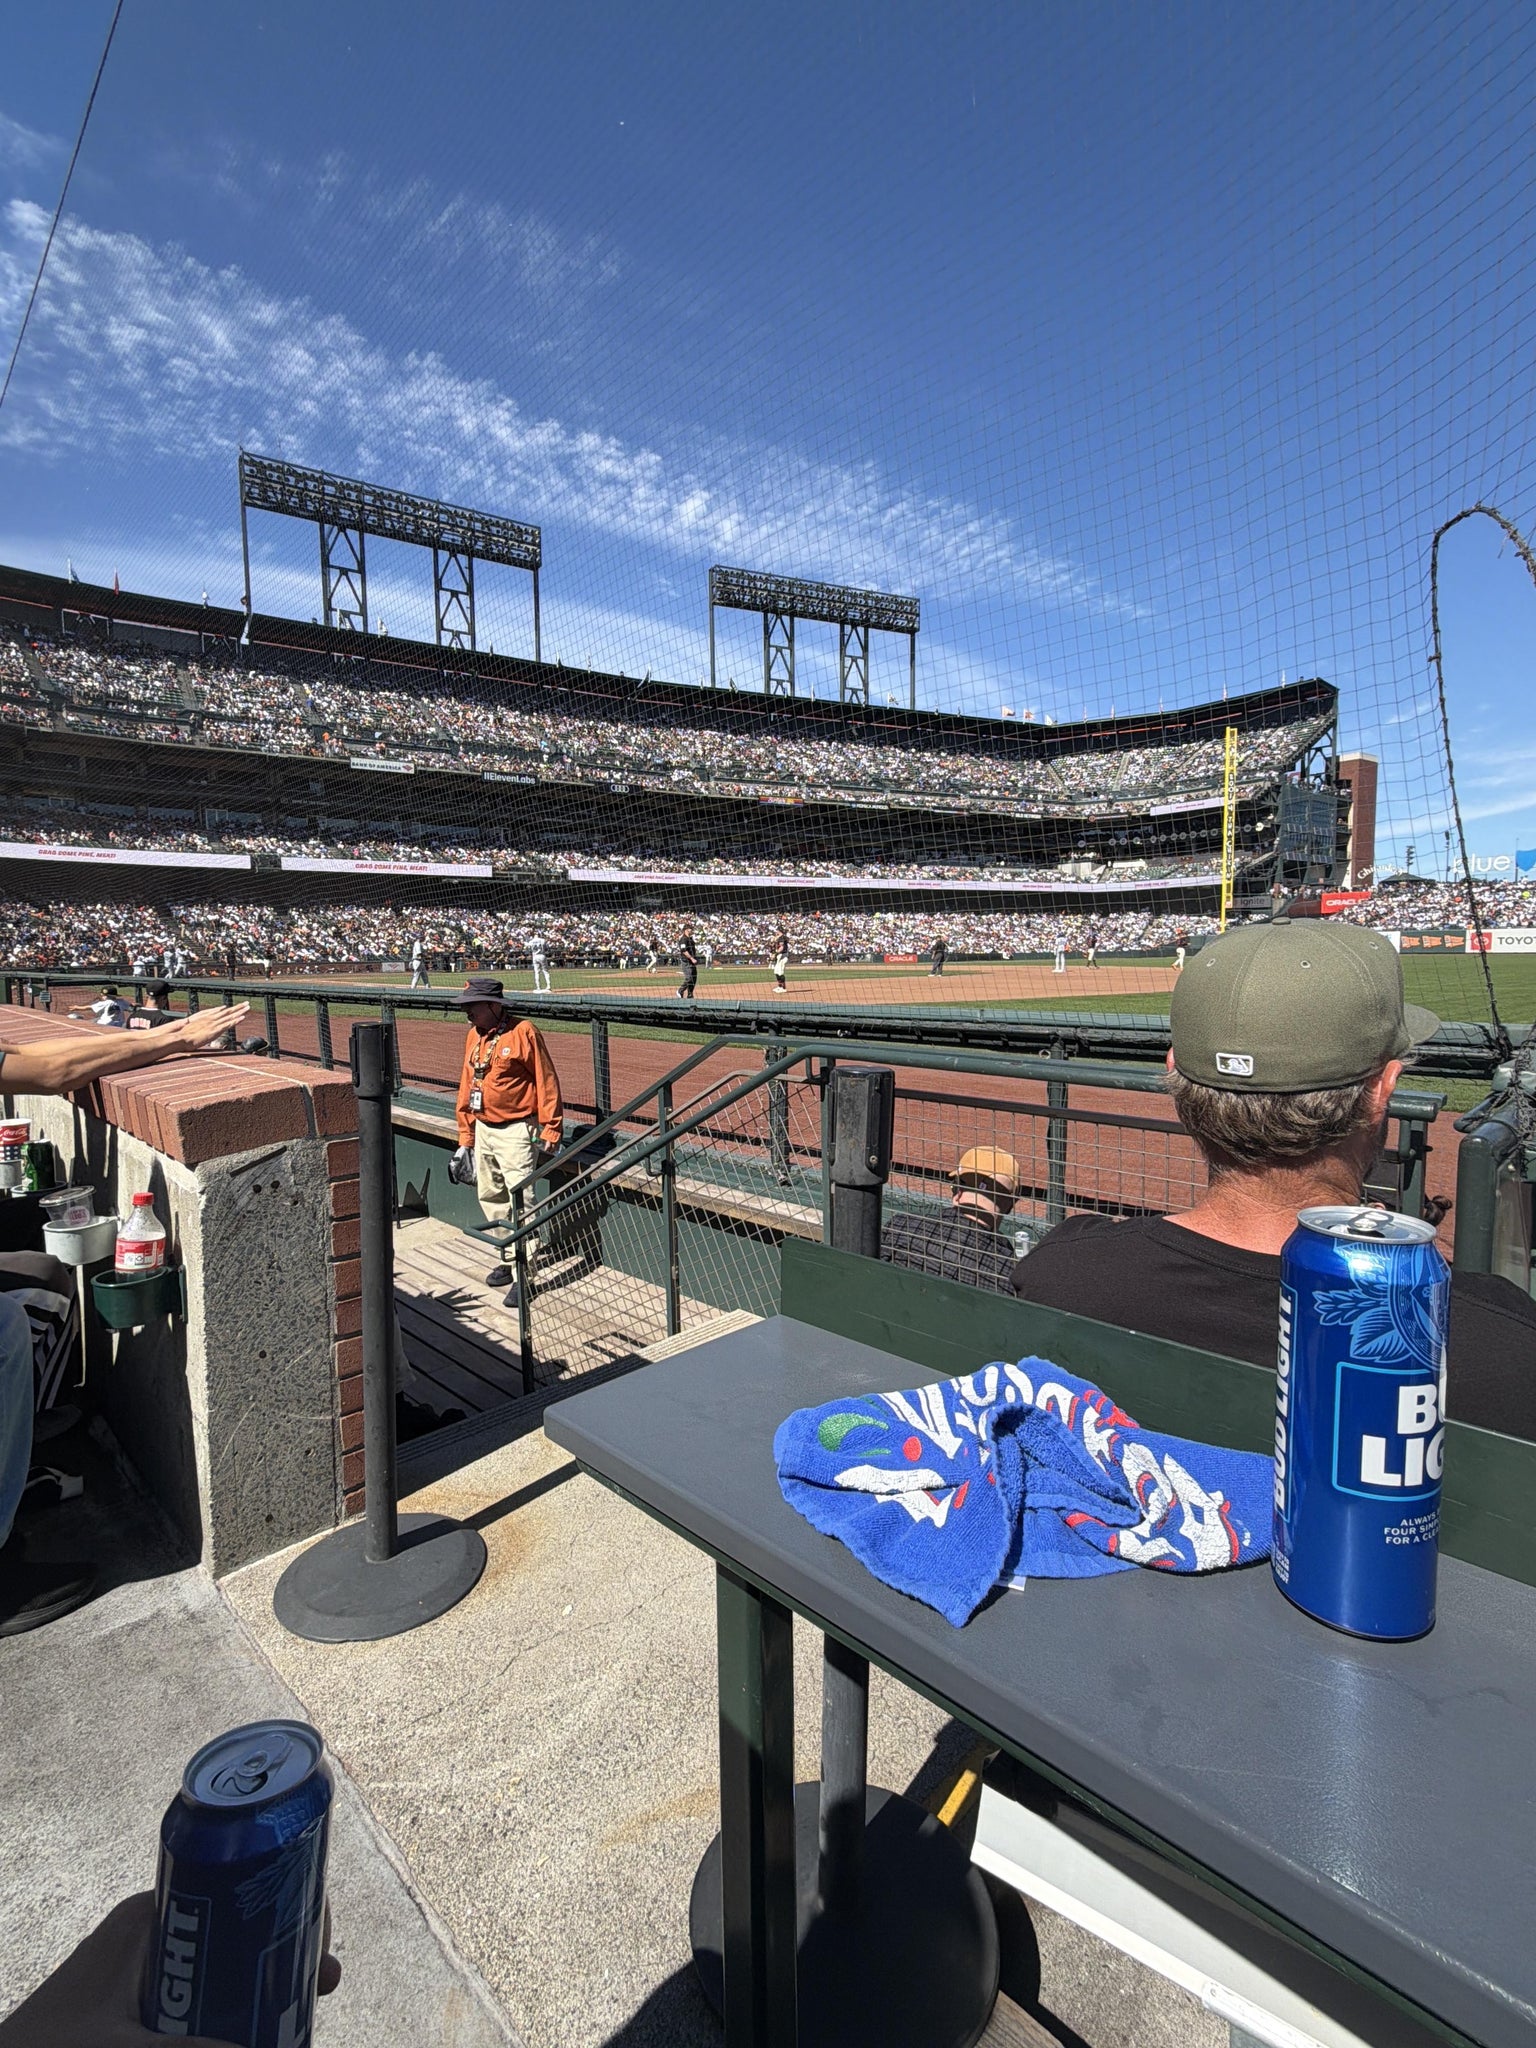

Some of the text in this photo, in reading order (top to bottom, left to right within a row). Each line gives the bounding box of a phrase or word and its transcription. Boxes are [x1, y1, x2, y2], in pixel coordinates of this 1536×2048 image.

[1274, 1287, 1291, 1510] BUD LIGHT
[1400, 1511, 1436, 1526] ALWAYS
[1384, 1527, 1416, 1536] FOUR
[1385, 1536, 1410, 1545] FOR
[1413, 1534, 1421, 1543] A
[158, 1901, 199, 2035] IGHT
